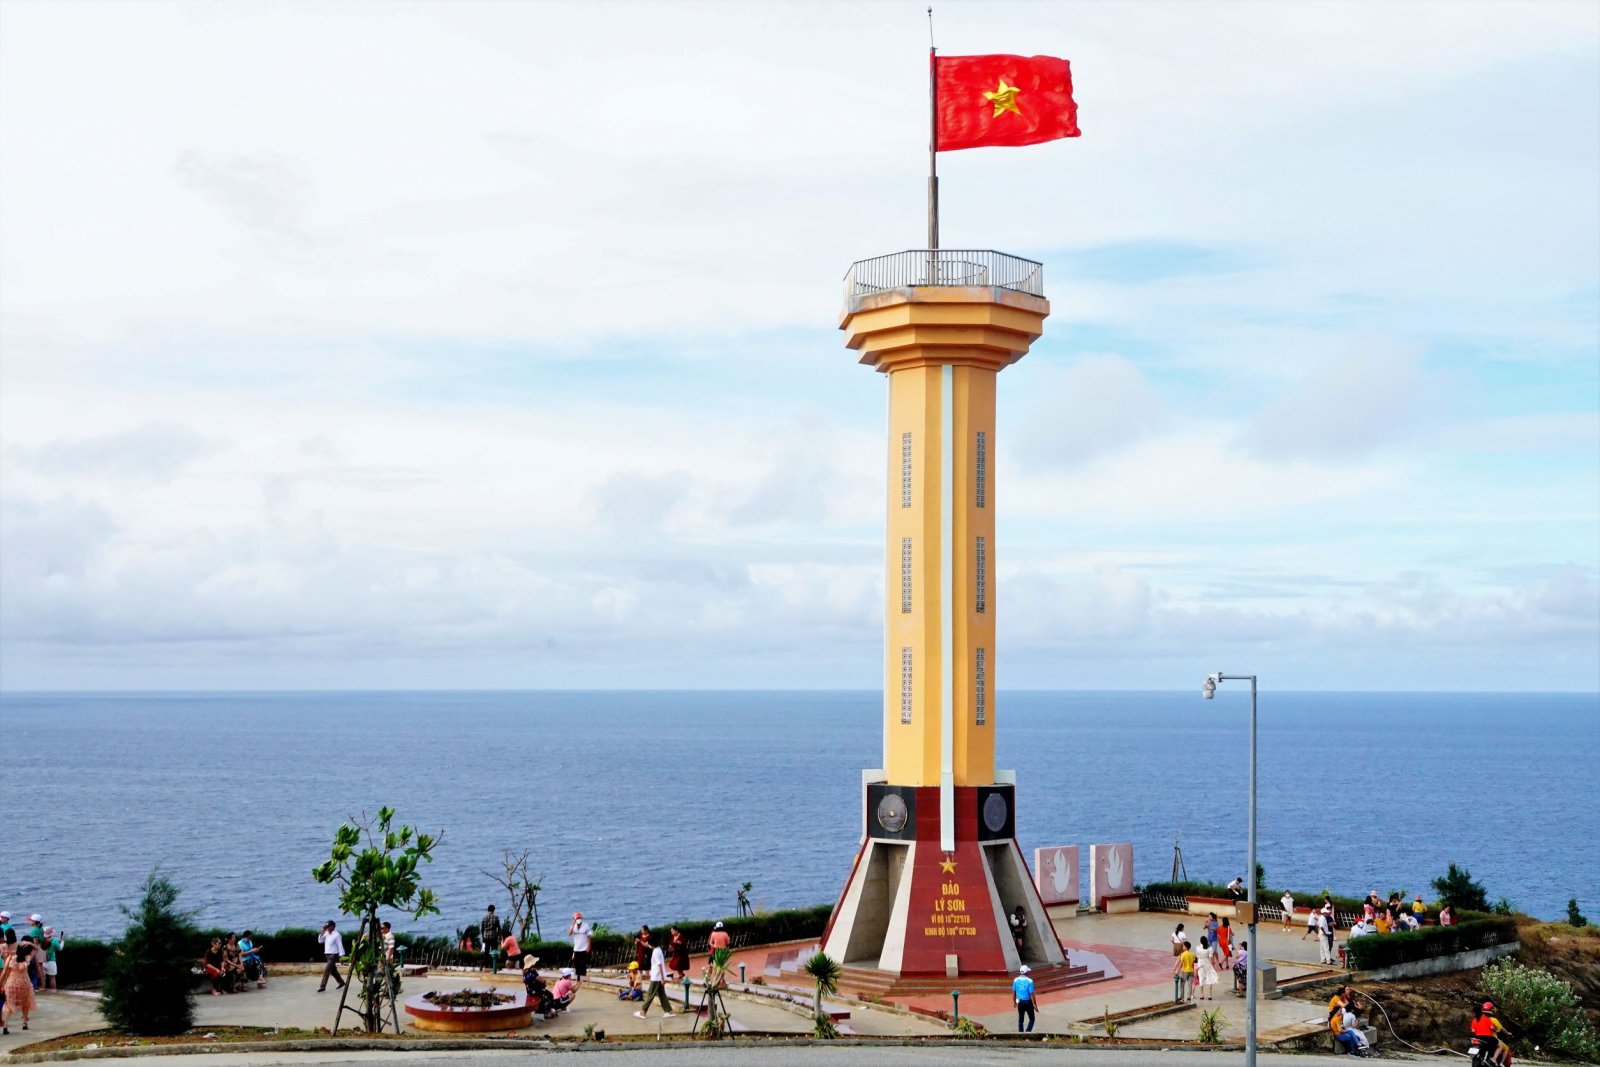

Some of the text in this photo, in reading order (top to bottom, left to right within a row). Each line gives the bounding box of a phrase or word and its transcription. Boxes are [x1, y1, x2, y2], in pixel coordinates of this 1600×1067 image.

[942, 880, 959, 895] ĐẢO
[935, 897, 965, 911] LÝ SƠN
